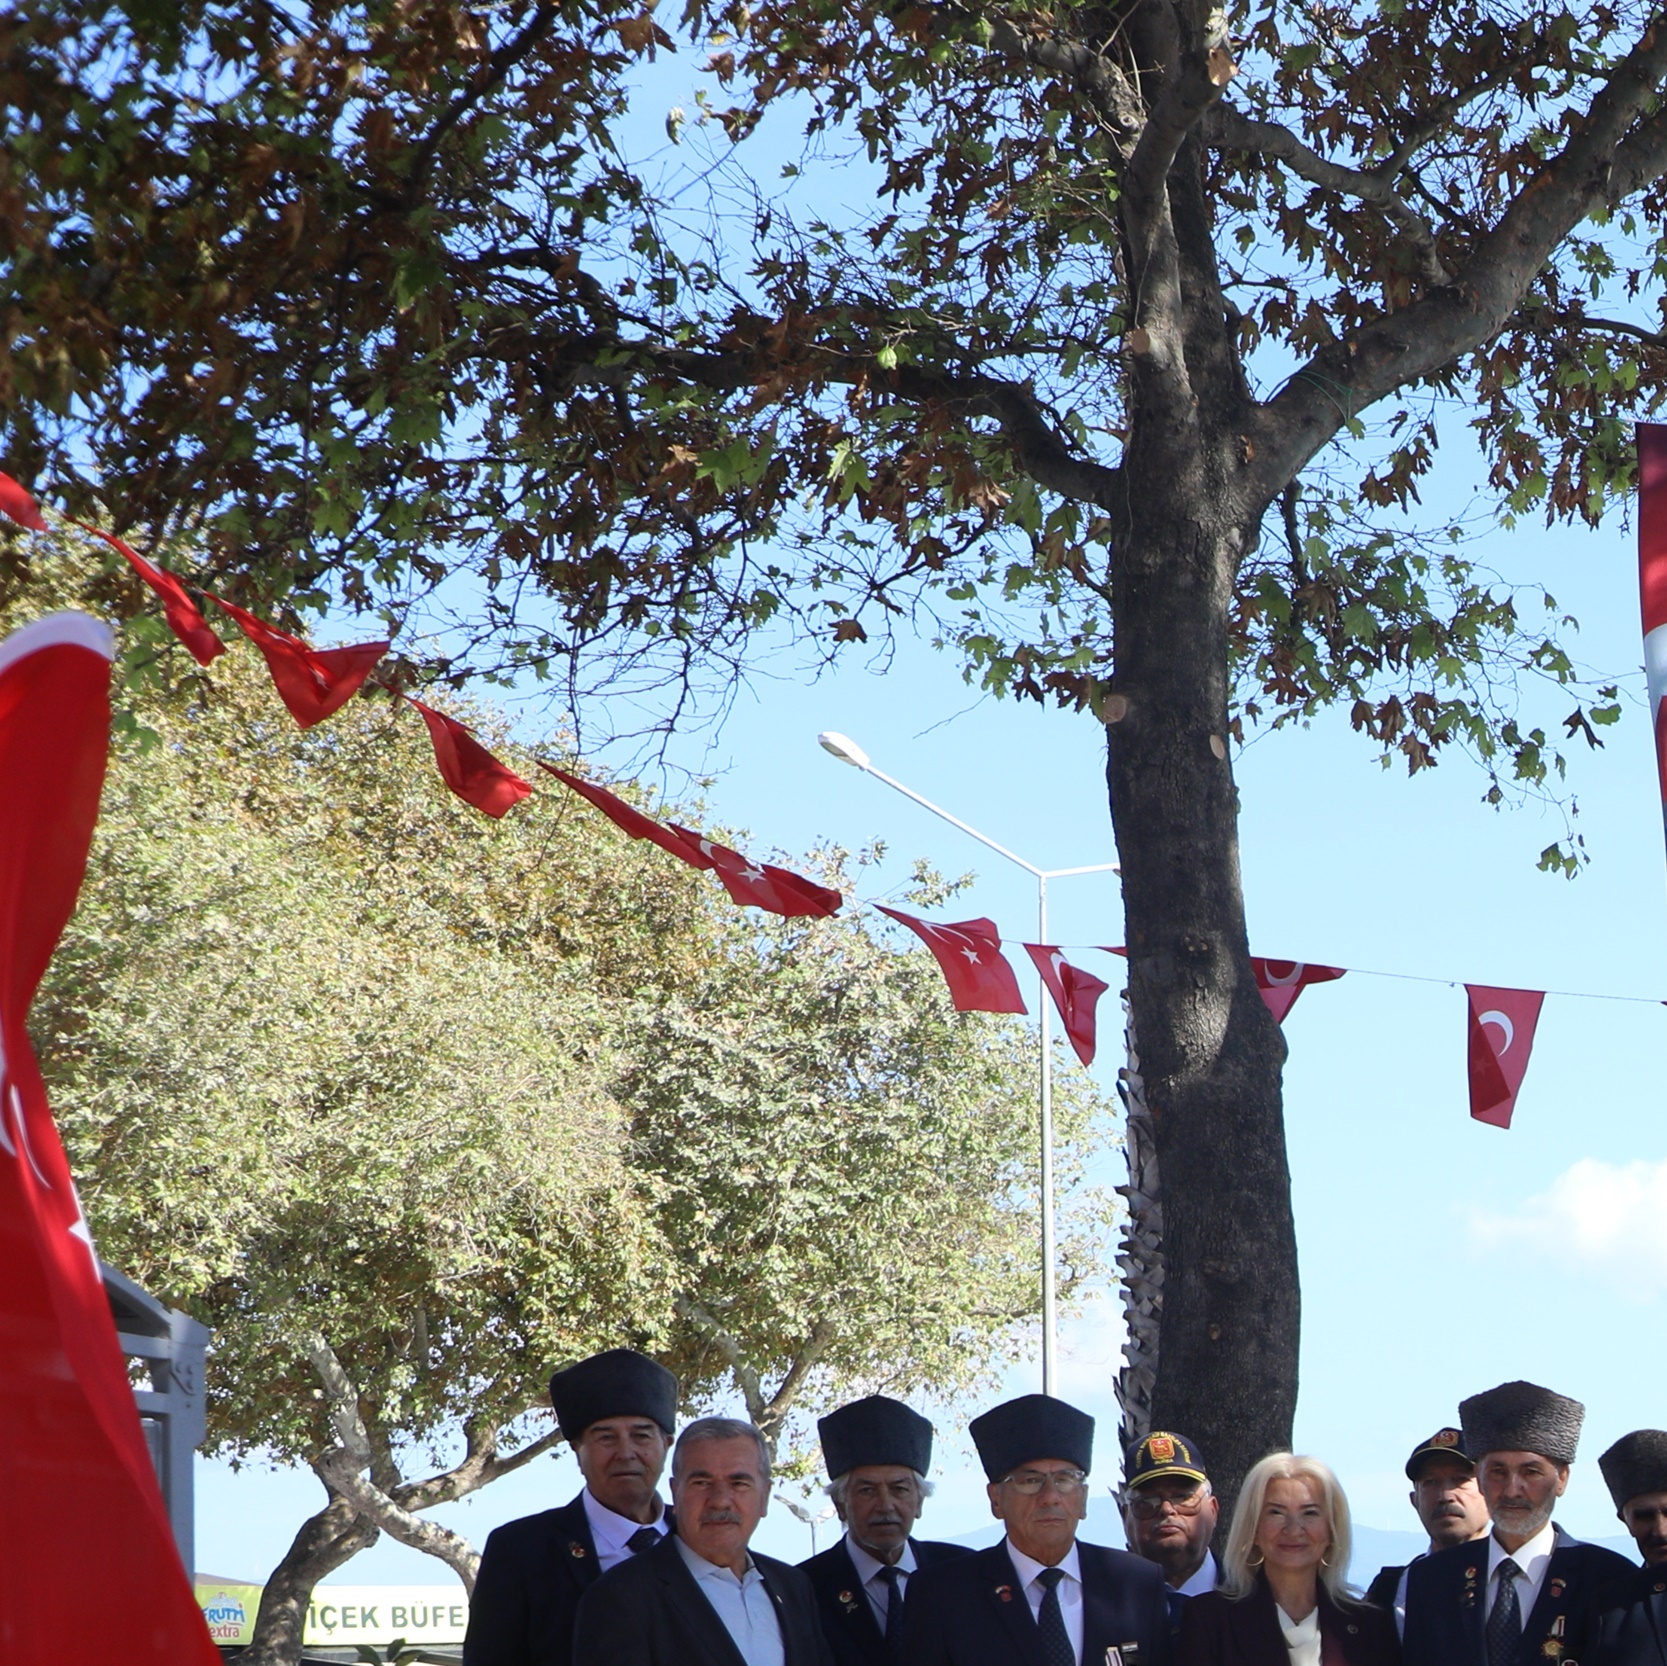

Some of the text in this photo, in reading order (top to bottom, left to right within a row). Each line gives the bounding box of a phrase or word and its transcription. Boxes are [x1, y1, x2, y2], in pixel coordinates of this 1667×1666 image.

[309, 1600, 464, 1636] İÇEK BÜFE
[209, 1625, 240, 1638] extra
